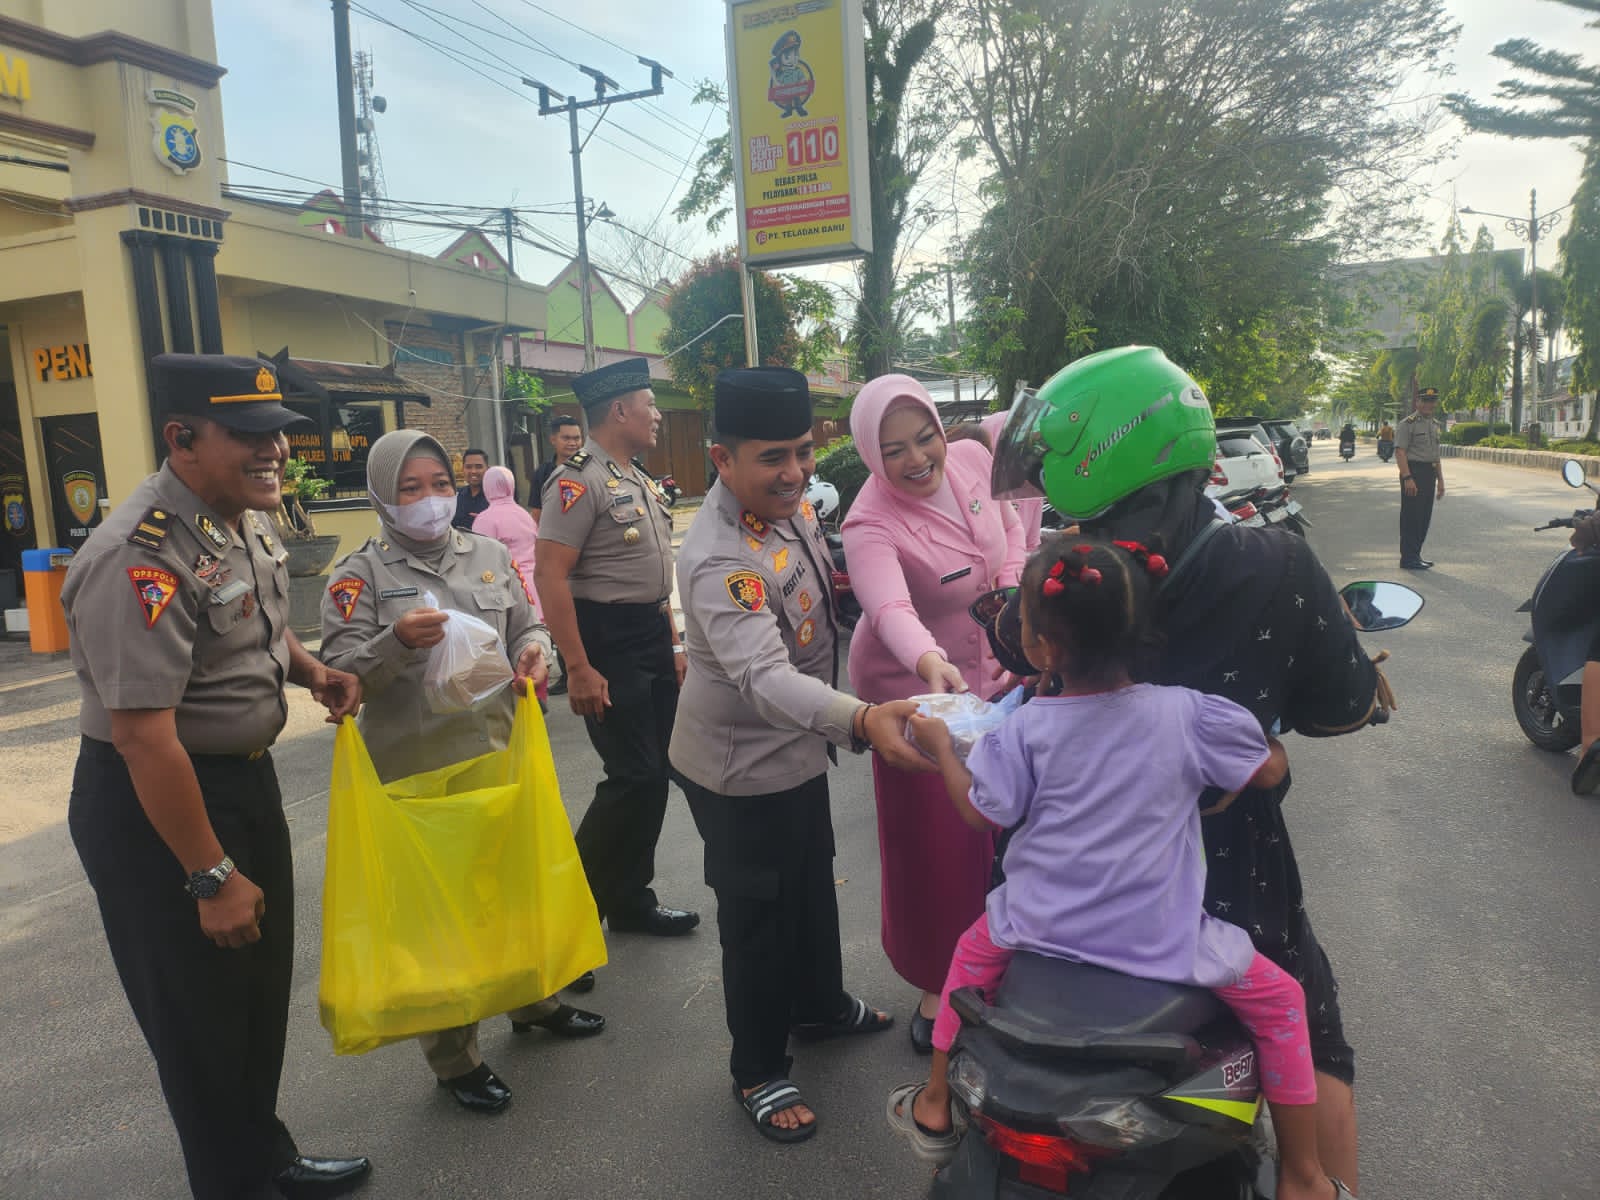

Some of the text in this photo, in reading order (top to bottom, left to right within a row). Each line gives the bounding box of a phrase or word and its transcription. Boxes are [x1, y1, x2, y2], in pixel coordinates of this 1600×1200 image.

[789, 130, 838, 162] 110
[782, 227, 819, 239] TELADAN
[822, 223, 845, 233] BARU
[34, 344, 93, 382] PEN
